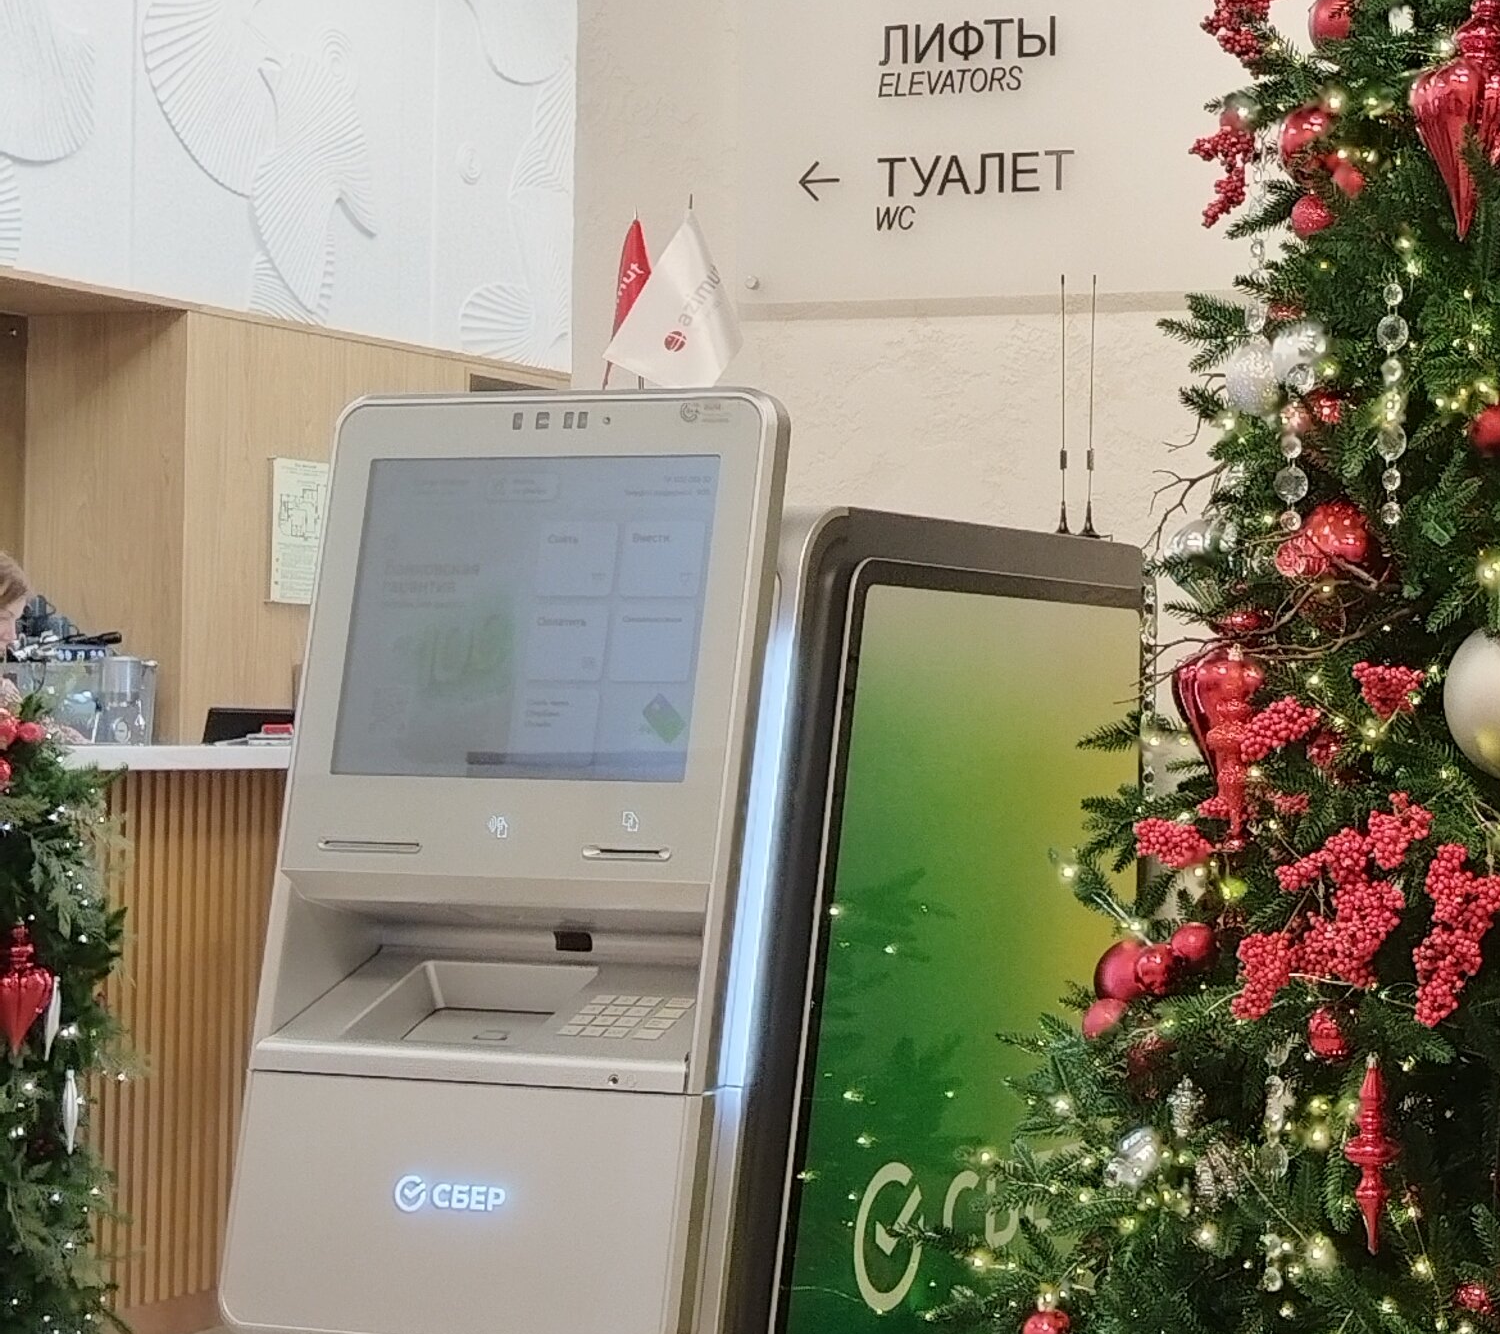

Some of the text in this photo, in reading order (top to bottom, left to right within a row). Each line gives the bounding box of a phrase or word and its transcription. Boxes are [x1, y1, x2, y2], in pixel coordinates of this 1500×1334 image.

[878, 15, 1056, 67] ЛИФТЫ
[878, 65, 1023, 98] ELEVATORS
[877, 149, 1075, 198] ТУАЛЕТ
[876, 205, 916, 232] WC
[432, 1183, 506, 1212] СБЕР
